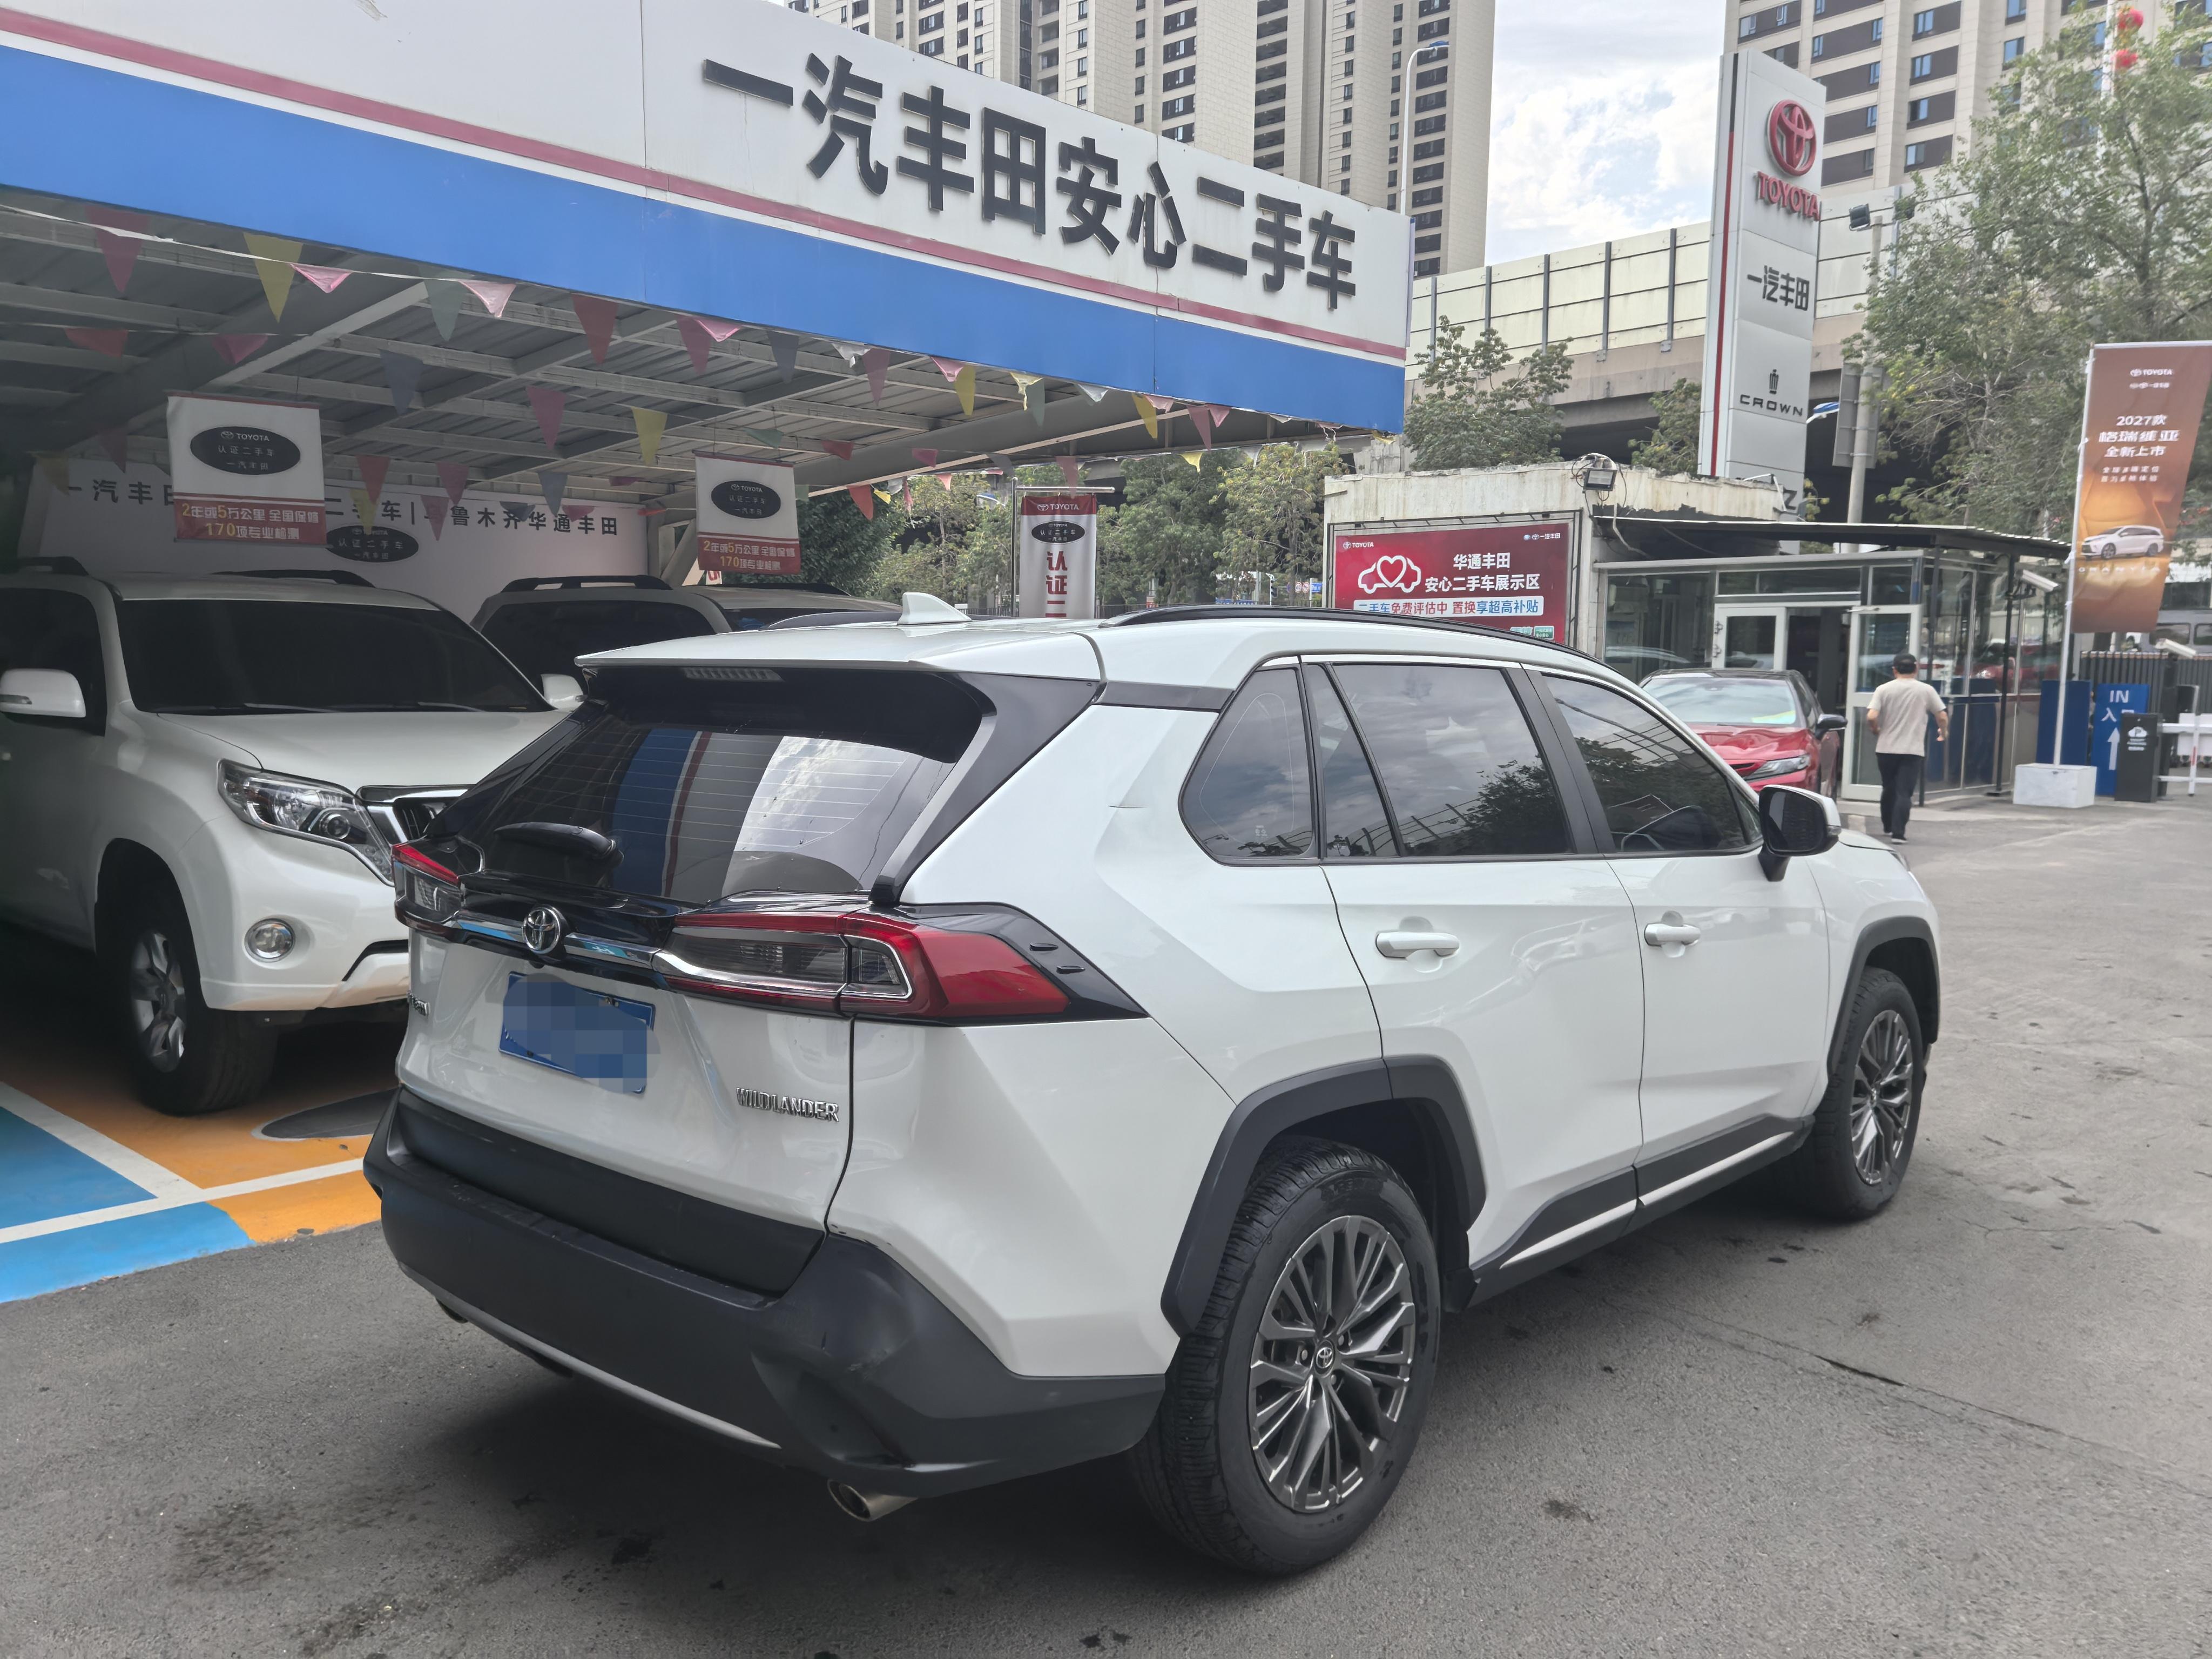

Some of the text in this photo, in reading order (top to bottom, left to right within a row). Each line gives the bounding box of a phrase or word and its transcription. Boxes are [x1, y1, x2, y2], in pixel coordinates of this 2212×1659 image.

[703, 52, 1357, 310] 一汽丰田安心二手车
[1757, 171, 1820, 221] TOYOTA
[1747, 265, 1810, 311] 一汽丰田
[1740, 394, 1803, 416] CROWN
[237, 433, 269, 441] TOYOTA
[2104, 446, 2167, 457] 全新上市
[1453, 552, 1510, 570] 华通丰田
[1425, 574, 1540, 593] 安心二手车展示区
[1453, 599, 1539, 614] 置换享超高补贴
[2109, 690, 2129, 703] IN
[2101, 707, 2135, 722] 入
[736, 1087, 839, 1122] WILDLANDER
